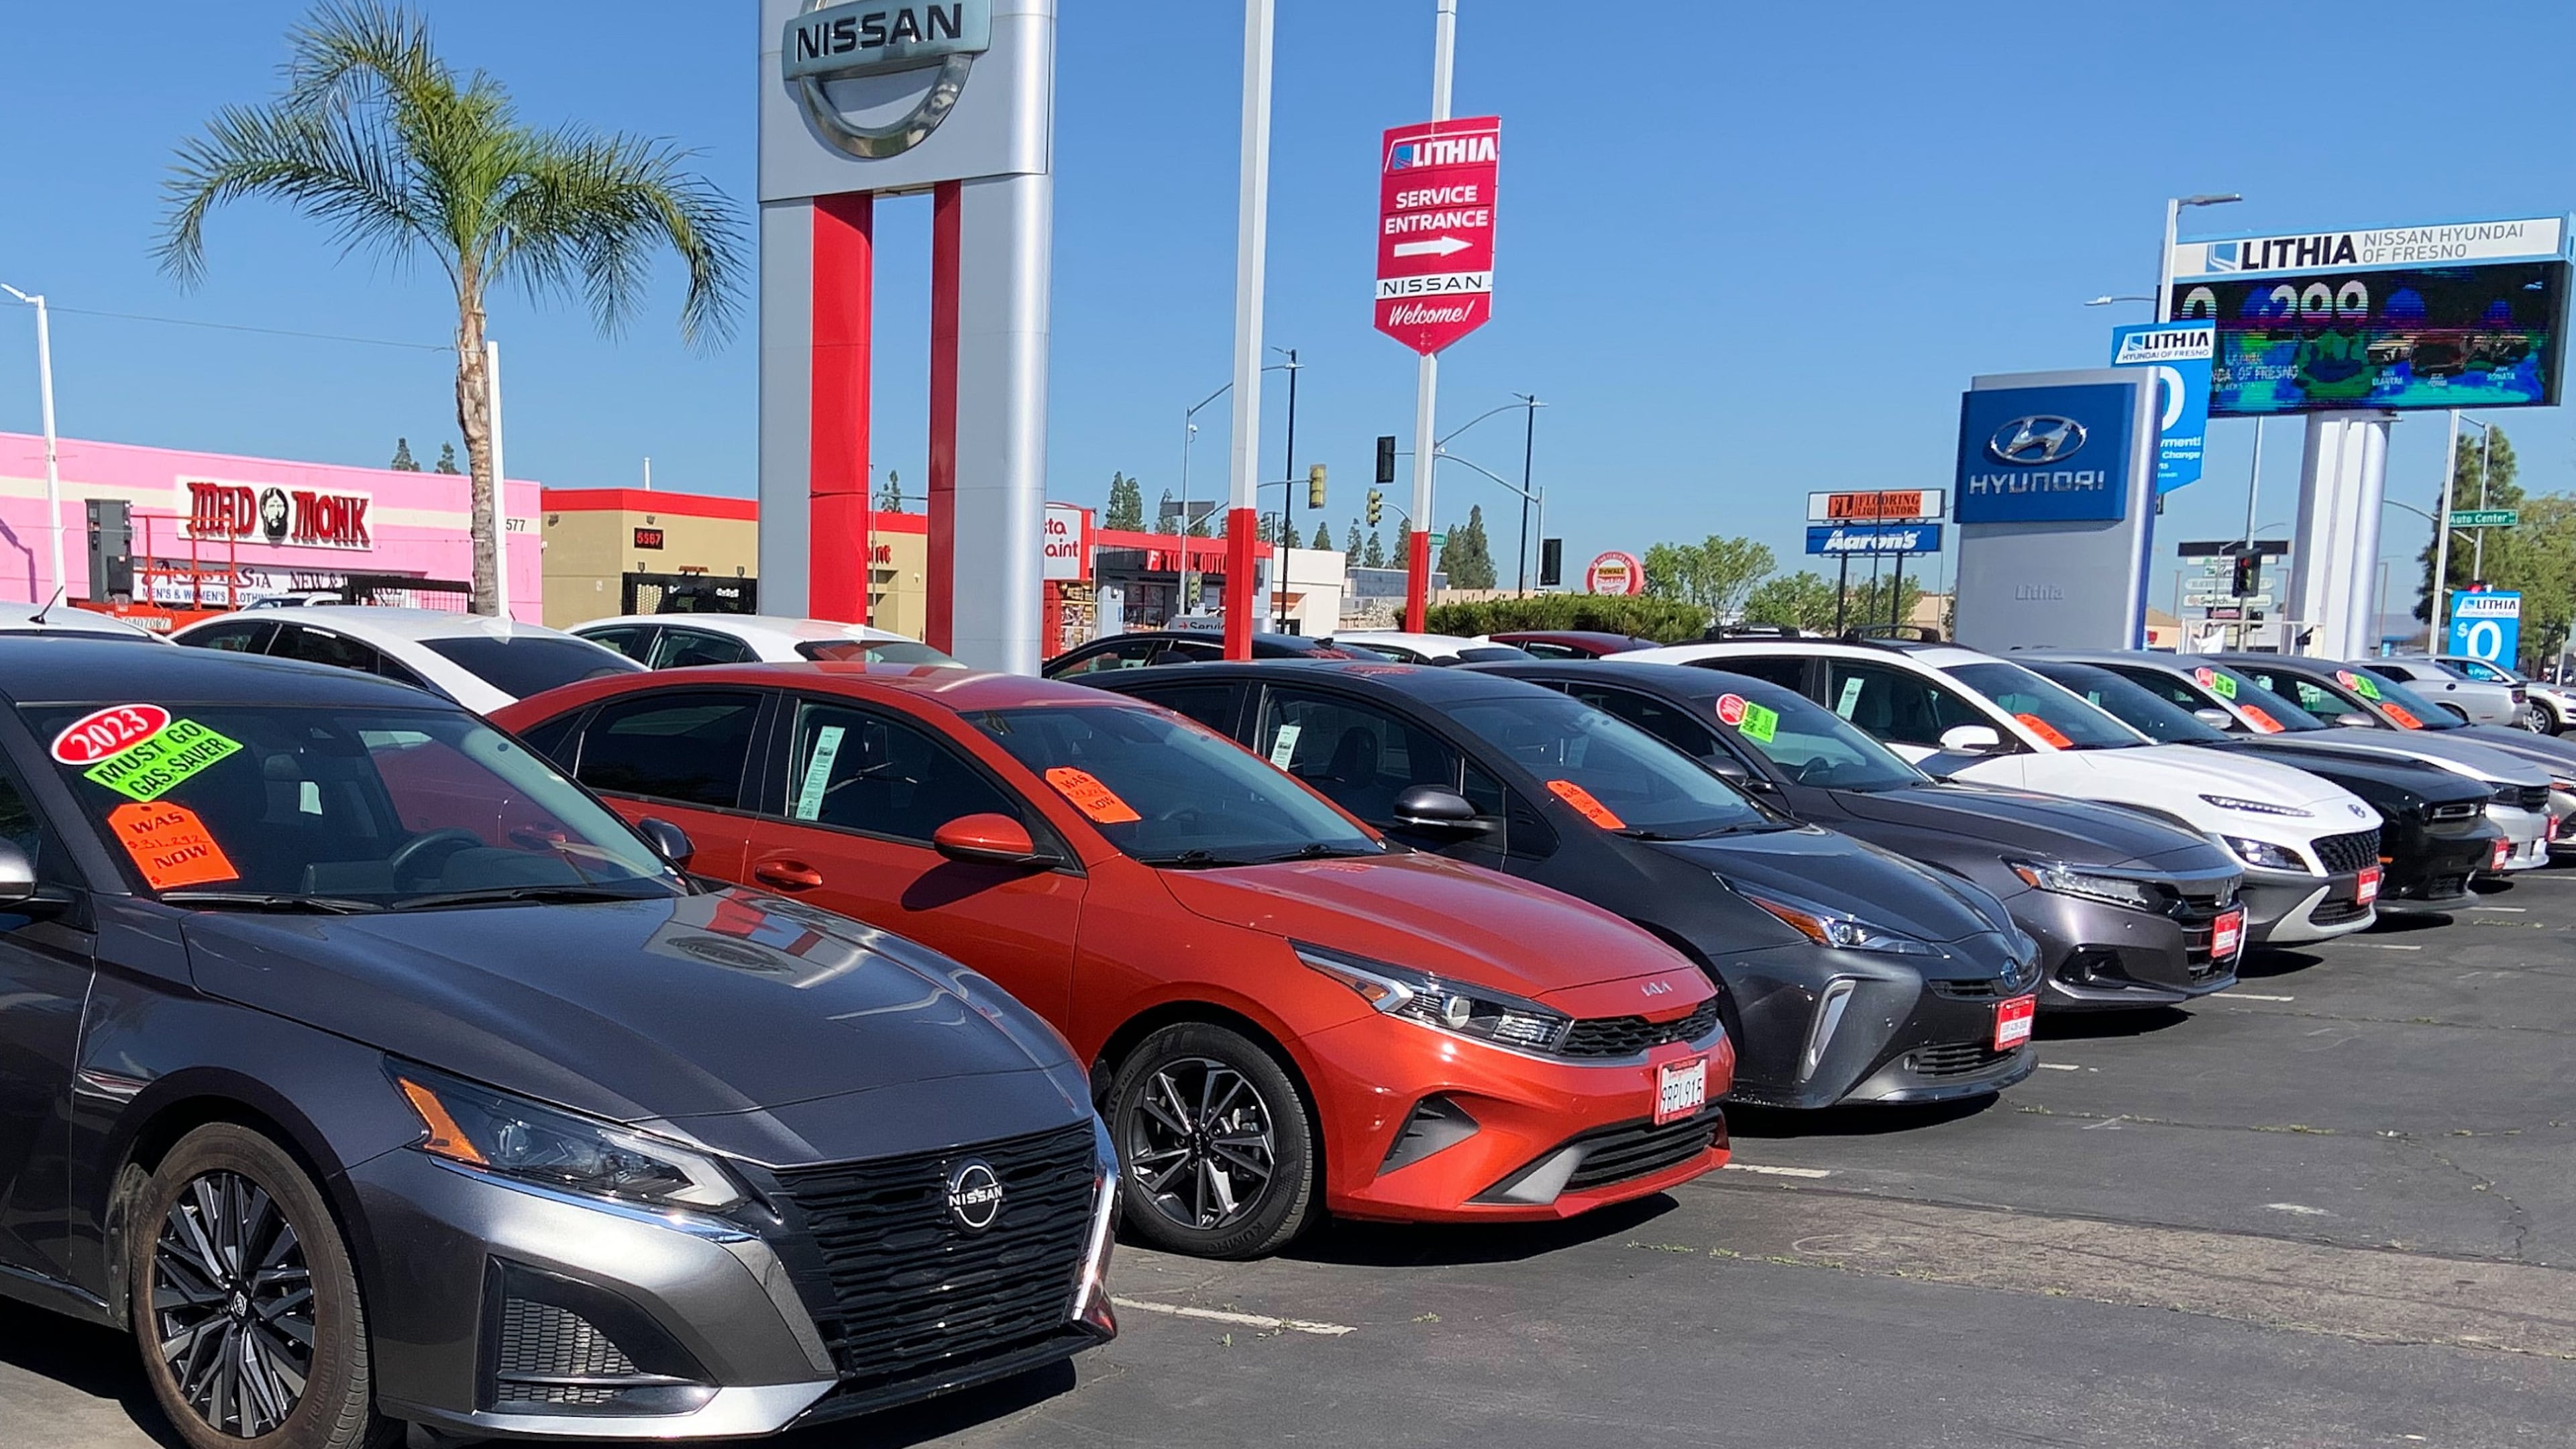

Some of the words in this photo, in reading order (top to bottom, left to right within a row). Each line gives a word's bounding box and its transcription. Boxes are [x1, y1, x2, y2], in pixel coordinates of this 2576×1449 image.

[796, 3, 961, 63] NISSAN
[1412, 137, 1496, 168] LITHIA
[1396, 185, 1478, 209] SERVICE
[1385, 209, 1489, 235] ENTRANCE
[2364, 229, 2437, 247] NISSAN
[2440, 223, 2524, 244] HYUNDAI
[2241, 233, 2357, 270] LITHIA
[2363, 248, 2387, 263] OF
[2392, 244, 2467, 260] FRESNO
[1383, 275, 1483, 296] NISSAN
[1389, 299, 1475, 326] Welcome!
[2144, 331, 2209, 350] LITHIA
[2123, 352, 2159, 361] HYUNDAI
[2174, 349, 2209, 358] FRESNO
[1969, 471, 2104, 495] HYUNDAI
[186, 482, 257, 536] MAD
[290, 490, 370, 546] MONK
[1857, 506, 1920, 516] LIQUDATORS
[2450, 515, 2472, 524] Auto
[2475, 514, 2508, 523] Center
[506, 519, 525, 531] 577
[1823, 530, 1917, 551] Aaron's
[1165, 551, 1197, 572] TOOL
[290, 572, 324, 589] NEW
[328, 573, 338, 589] &
[143, 588, 171, 599] MEN'S
[174, 590, 180, 599] &
[184, 590, 226, 602] WMEN'S
[2015, 584, 2064, 600] Lithia
[2477, 600, 2516, 609] LITHIA
[70, 709, 148, 759] 2023
[95, 739, 167, 784] MUST
[166, 723, 203, 743] GO
[128, 767, 172, 796] GAS
[170, 738, 229, 773] SAVER
[129, 811, 184, 834] WAS
[152, 845, 208, 869] NOW
[948, 1185, 1003, 1207] NISSAN
